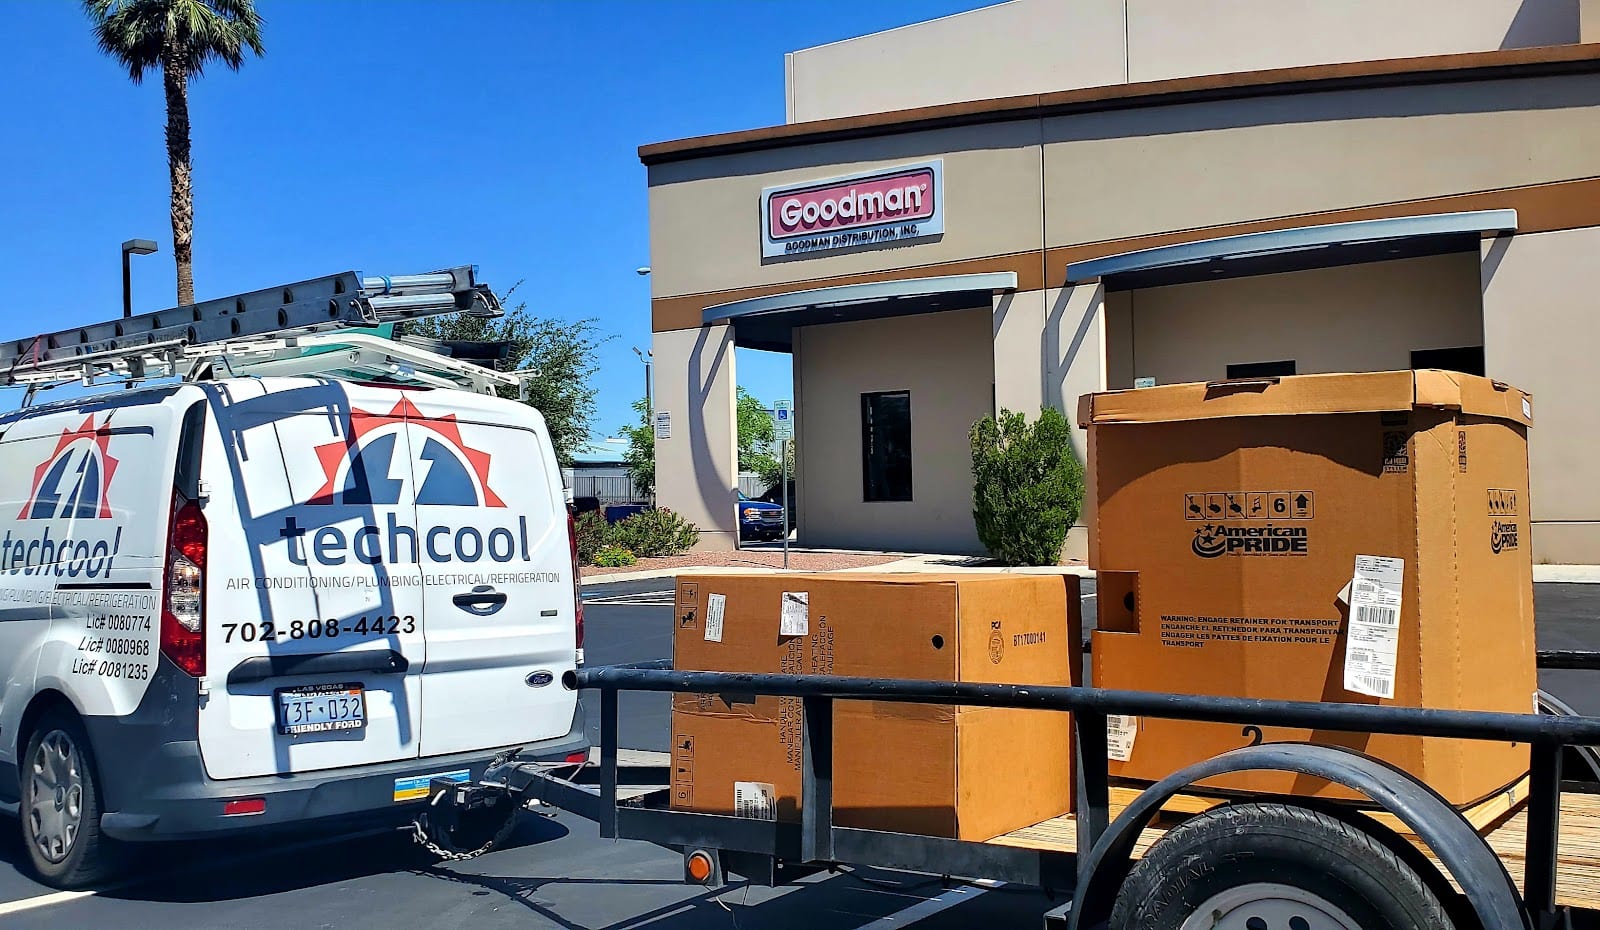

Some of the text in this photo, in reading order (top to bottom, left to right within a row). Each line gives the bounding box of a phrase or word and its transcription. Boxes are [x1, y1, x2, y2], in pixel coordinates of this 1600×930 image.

[780, 185, 922, 228] Goodman
[785, 237, 830, 251] GOODMAN
[832, 227, 898, 245] DISTRIBUTION,
[280, 512, 531, 566] techcool
[1214, 523, 1308, 537] American
[1226, 537, 1308, 552] PRIDE
[1501, 533, 1518, 548] PRIDE
[1, 526, 122, 578] techcool
[226, 577, 250, 590] AIR
[86, 614, 151, 632] Lic# 0080774
[221, 615, 416, 644] 702-808-4423
[1160, 615, 1197, 623] WARNING:
[1198, 616, 1228, 624] ENGAGE
[1230, 617, 1269, 625] RETAINER
[1288, 619, 1339, 627] TRANSPORT
[78, 636, 149, 656] Lic# 0080968
[1161, 639, 1204, 648] TRANSPORT
[1254, 635, 1292, 643] FIXATION
[1294, 636, 1318, 644] POUR
[811, 634, 819, 674] HEATING
[72, 658, 148, 681] Lic# 0081235
[780, 655, 788, 674] ARE
[284, 720, 362, 734] FRIENDLY FORD
[779, 708, 788, 744] HANDLE
